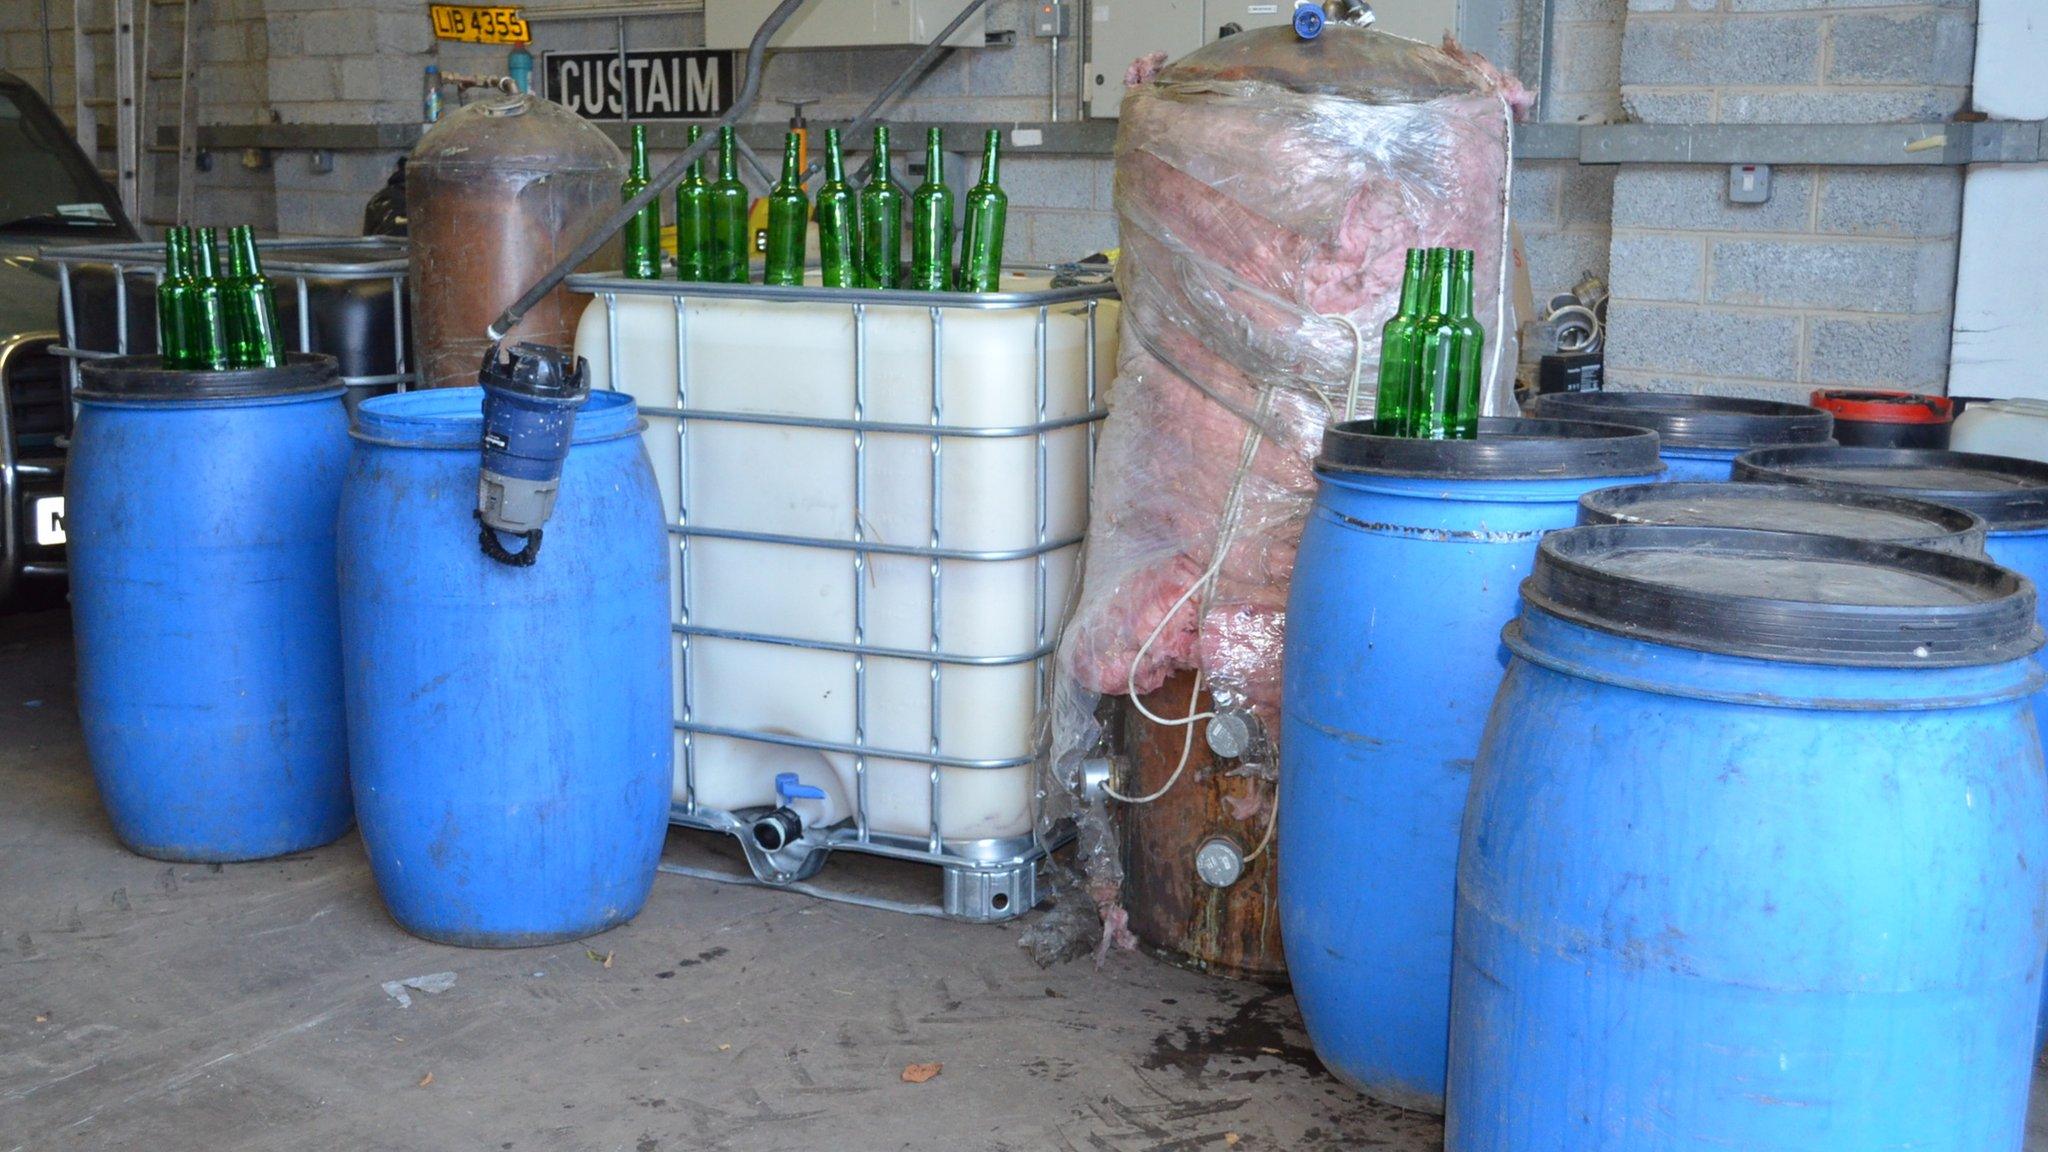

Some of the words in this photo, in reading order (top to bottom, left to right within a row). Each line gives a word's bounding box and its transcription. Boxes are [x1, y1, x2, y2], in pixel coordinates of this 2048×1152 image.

[435, 8, 466, 34] LIB
[471, 11, 523, 36] 4355
[560, 56, 720, 115] CUSTAIM
